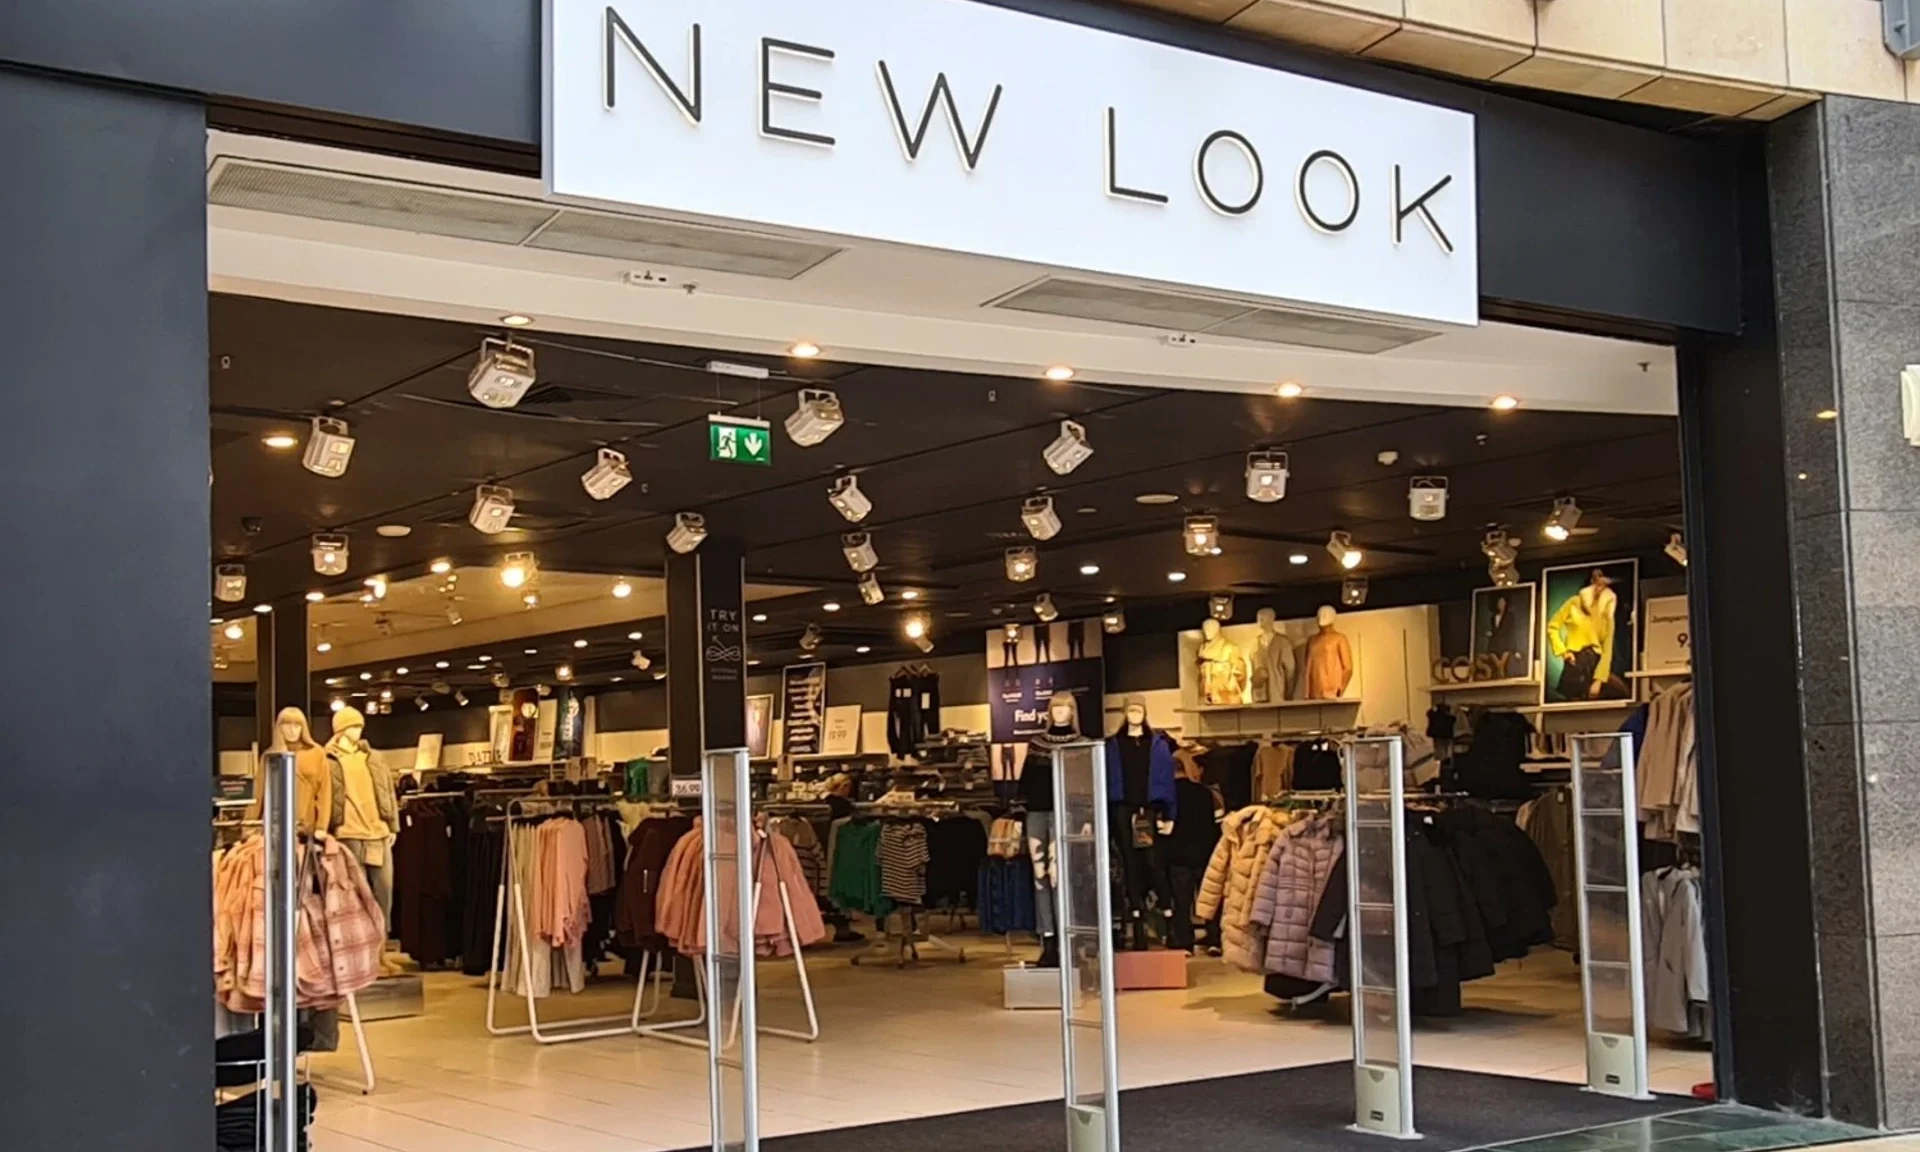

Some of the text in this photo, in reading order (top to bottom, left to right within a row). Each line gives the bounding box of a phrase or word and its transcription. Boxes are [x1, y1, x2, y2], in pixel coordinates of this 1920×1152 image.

[605, 7, 1454, 255] NEW LOOK
[709, 608, 738, 621] TRY
[707, 622, 740, 633] IT ON
[1432, 652, 1511, 685] COSY
[1014, 708, 1037, 723] Find
